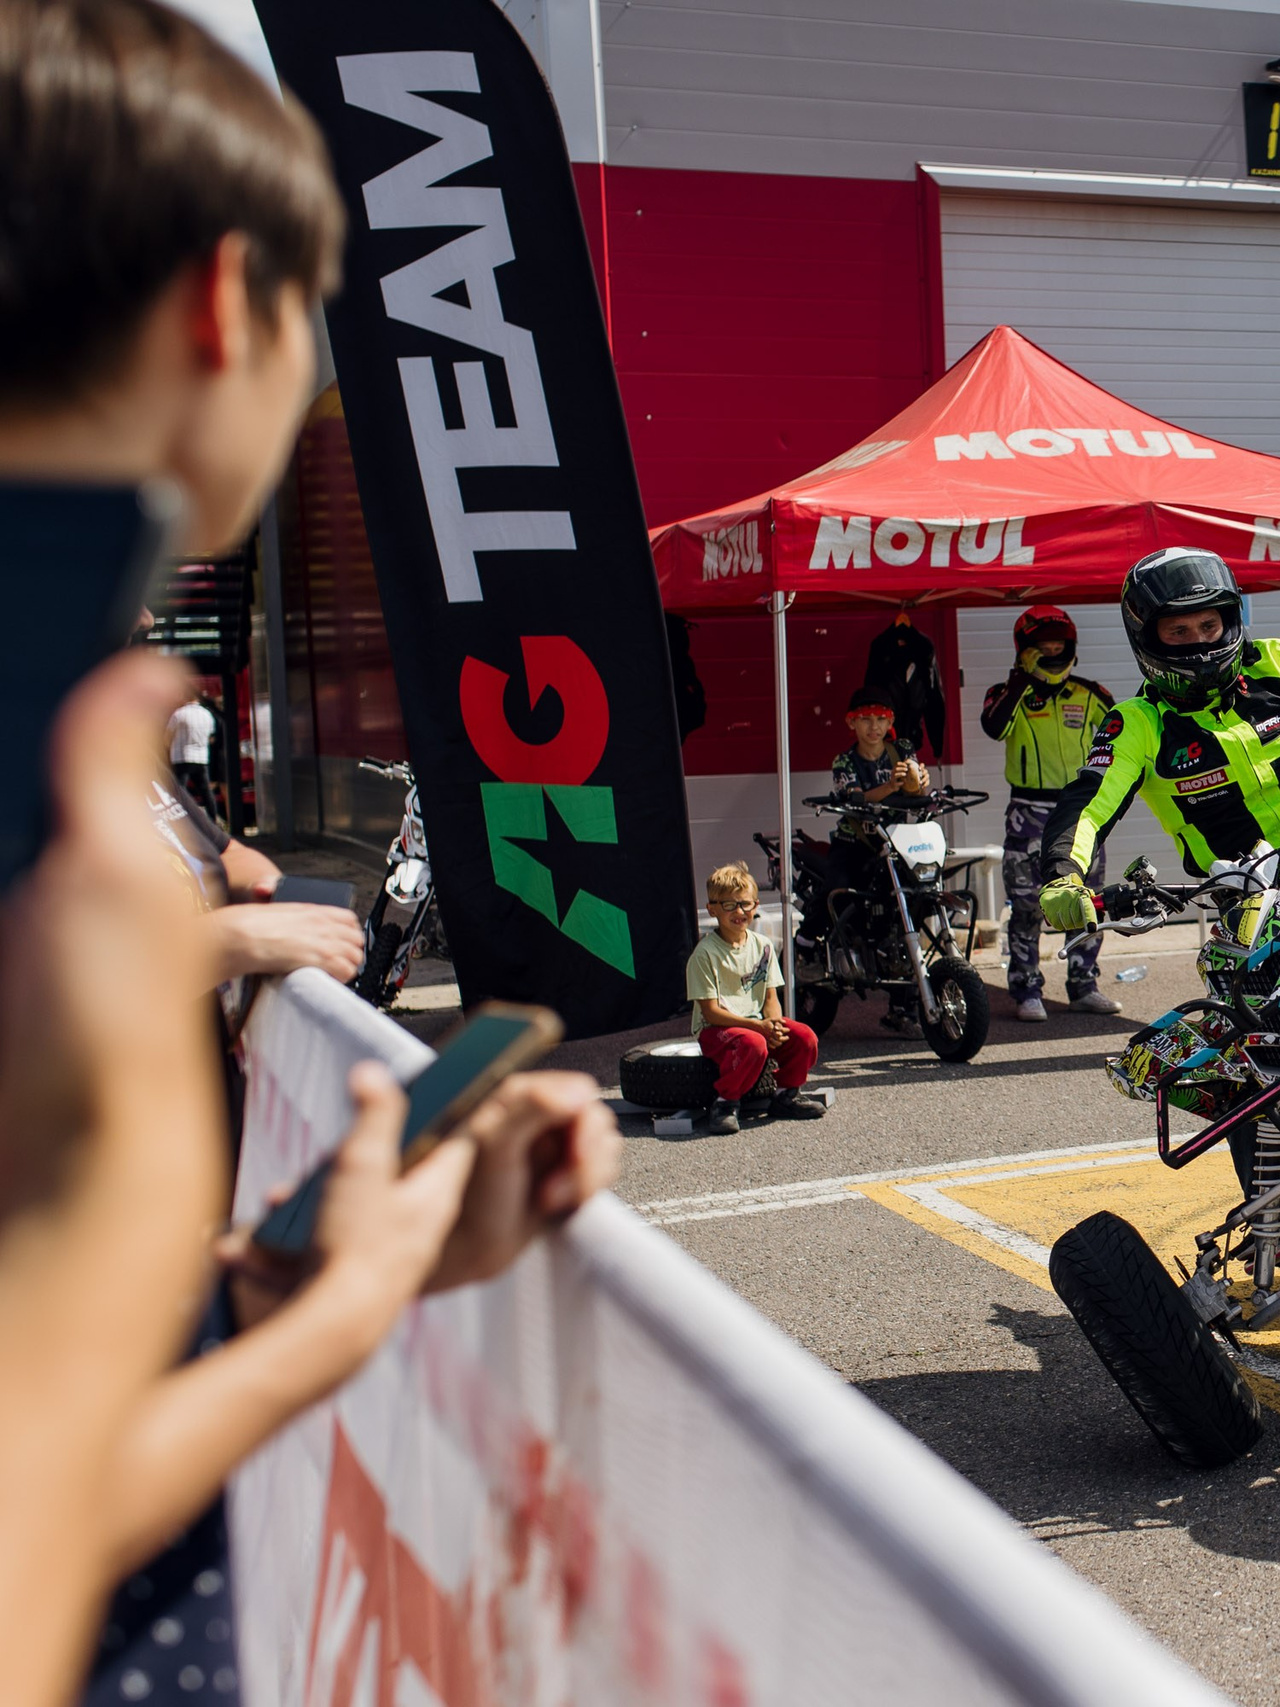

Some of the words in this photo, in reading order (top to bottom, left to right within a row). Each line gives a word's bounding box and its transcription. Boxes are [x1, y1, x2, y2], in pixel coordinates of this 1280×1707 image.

[335, 50, 577, 603] TEAM
[933, 428, 1217, 461] MOTUL
[702, 520, 763, 582] MOTUL
[808, 515, 1035, 570] MOTUL
[1171, 741, 1203, 767] AG
[1177, 757, 1200, 770] TEAM
[1180, 772, 1225, 791] MOTUL
